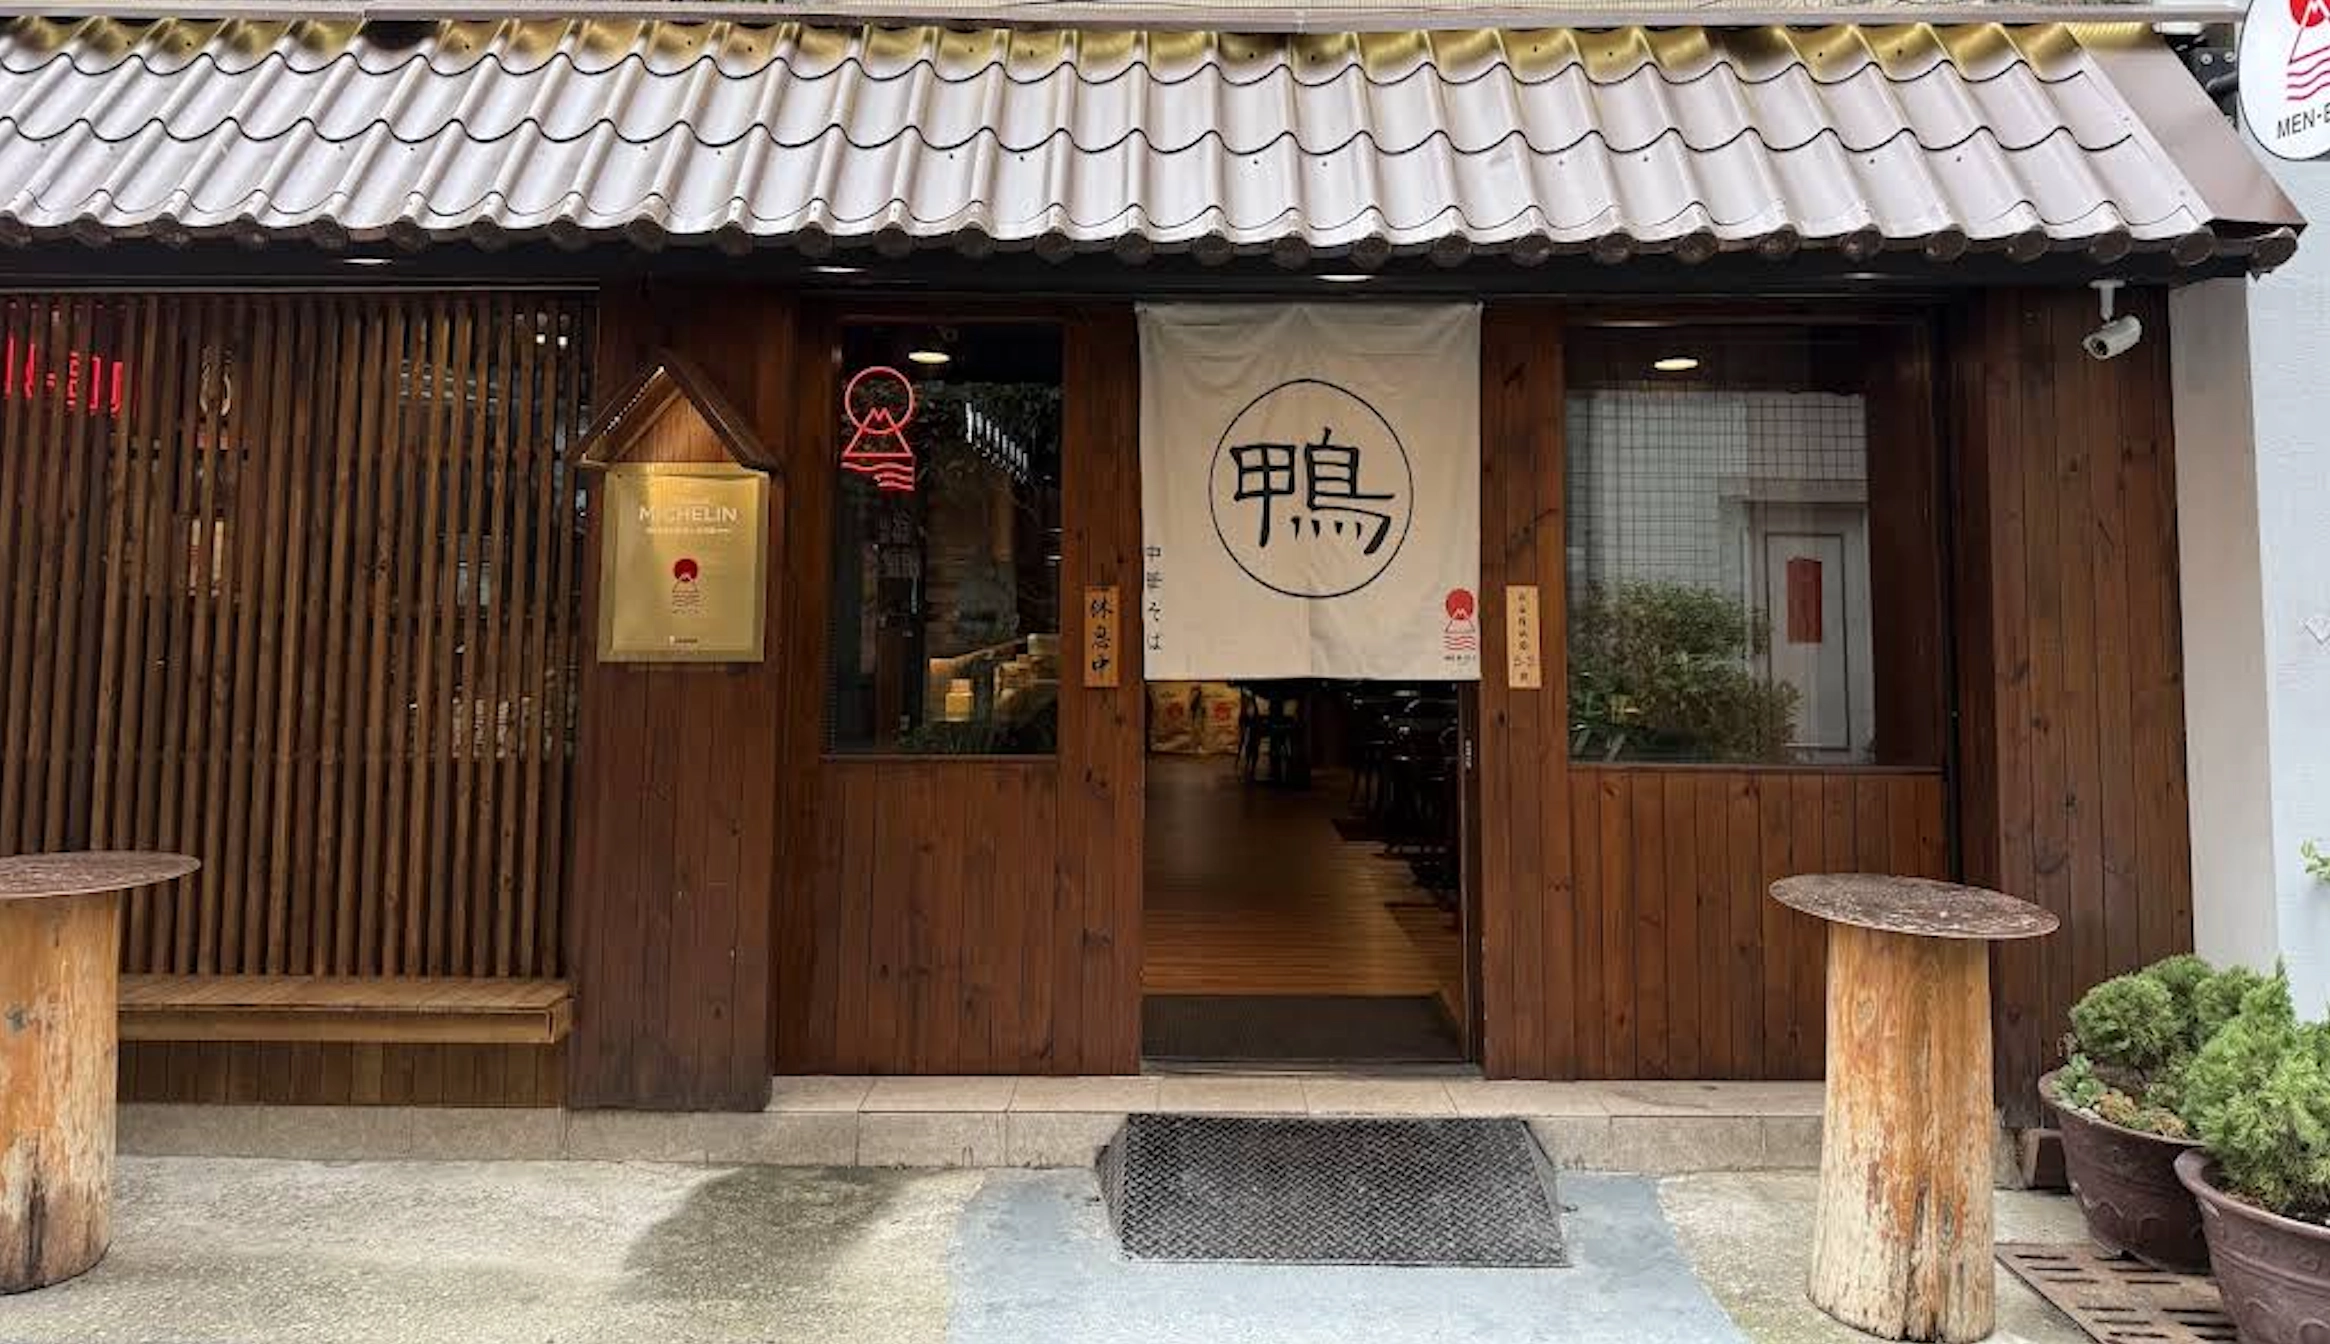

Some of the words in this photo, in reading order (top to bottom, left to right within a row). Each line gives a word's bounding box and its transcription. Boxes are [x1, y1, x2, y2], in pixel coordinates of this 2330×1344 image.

[639, 506, 738, 521] MCHELIN
[1229, 427, 1396, 555] 鴨
[1091, 596, 1114, 672] 休息中
